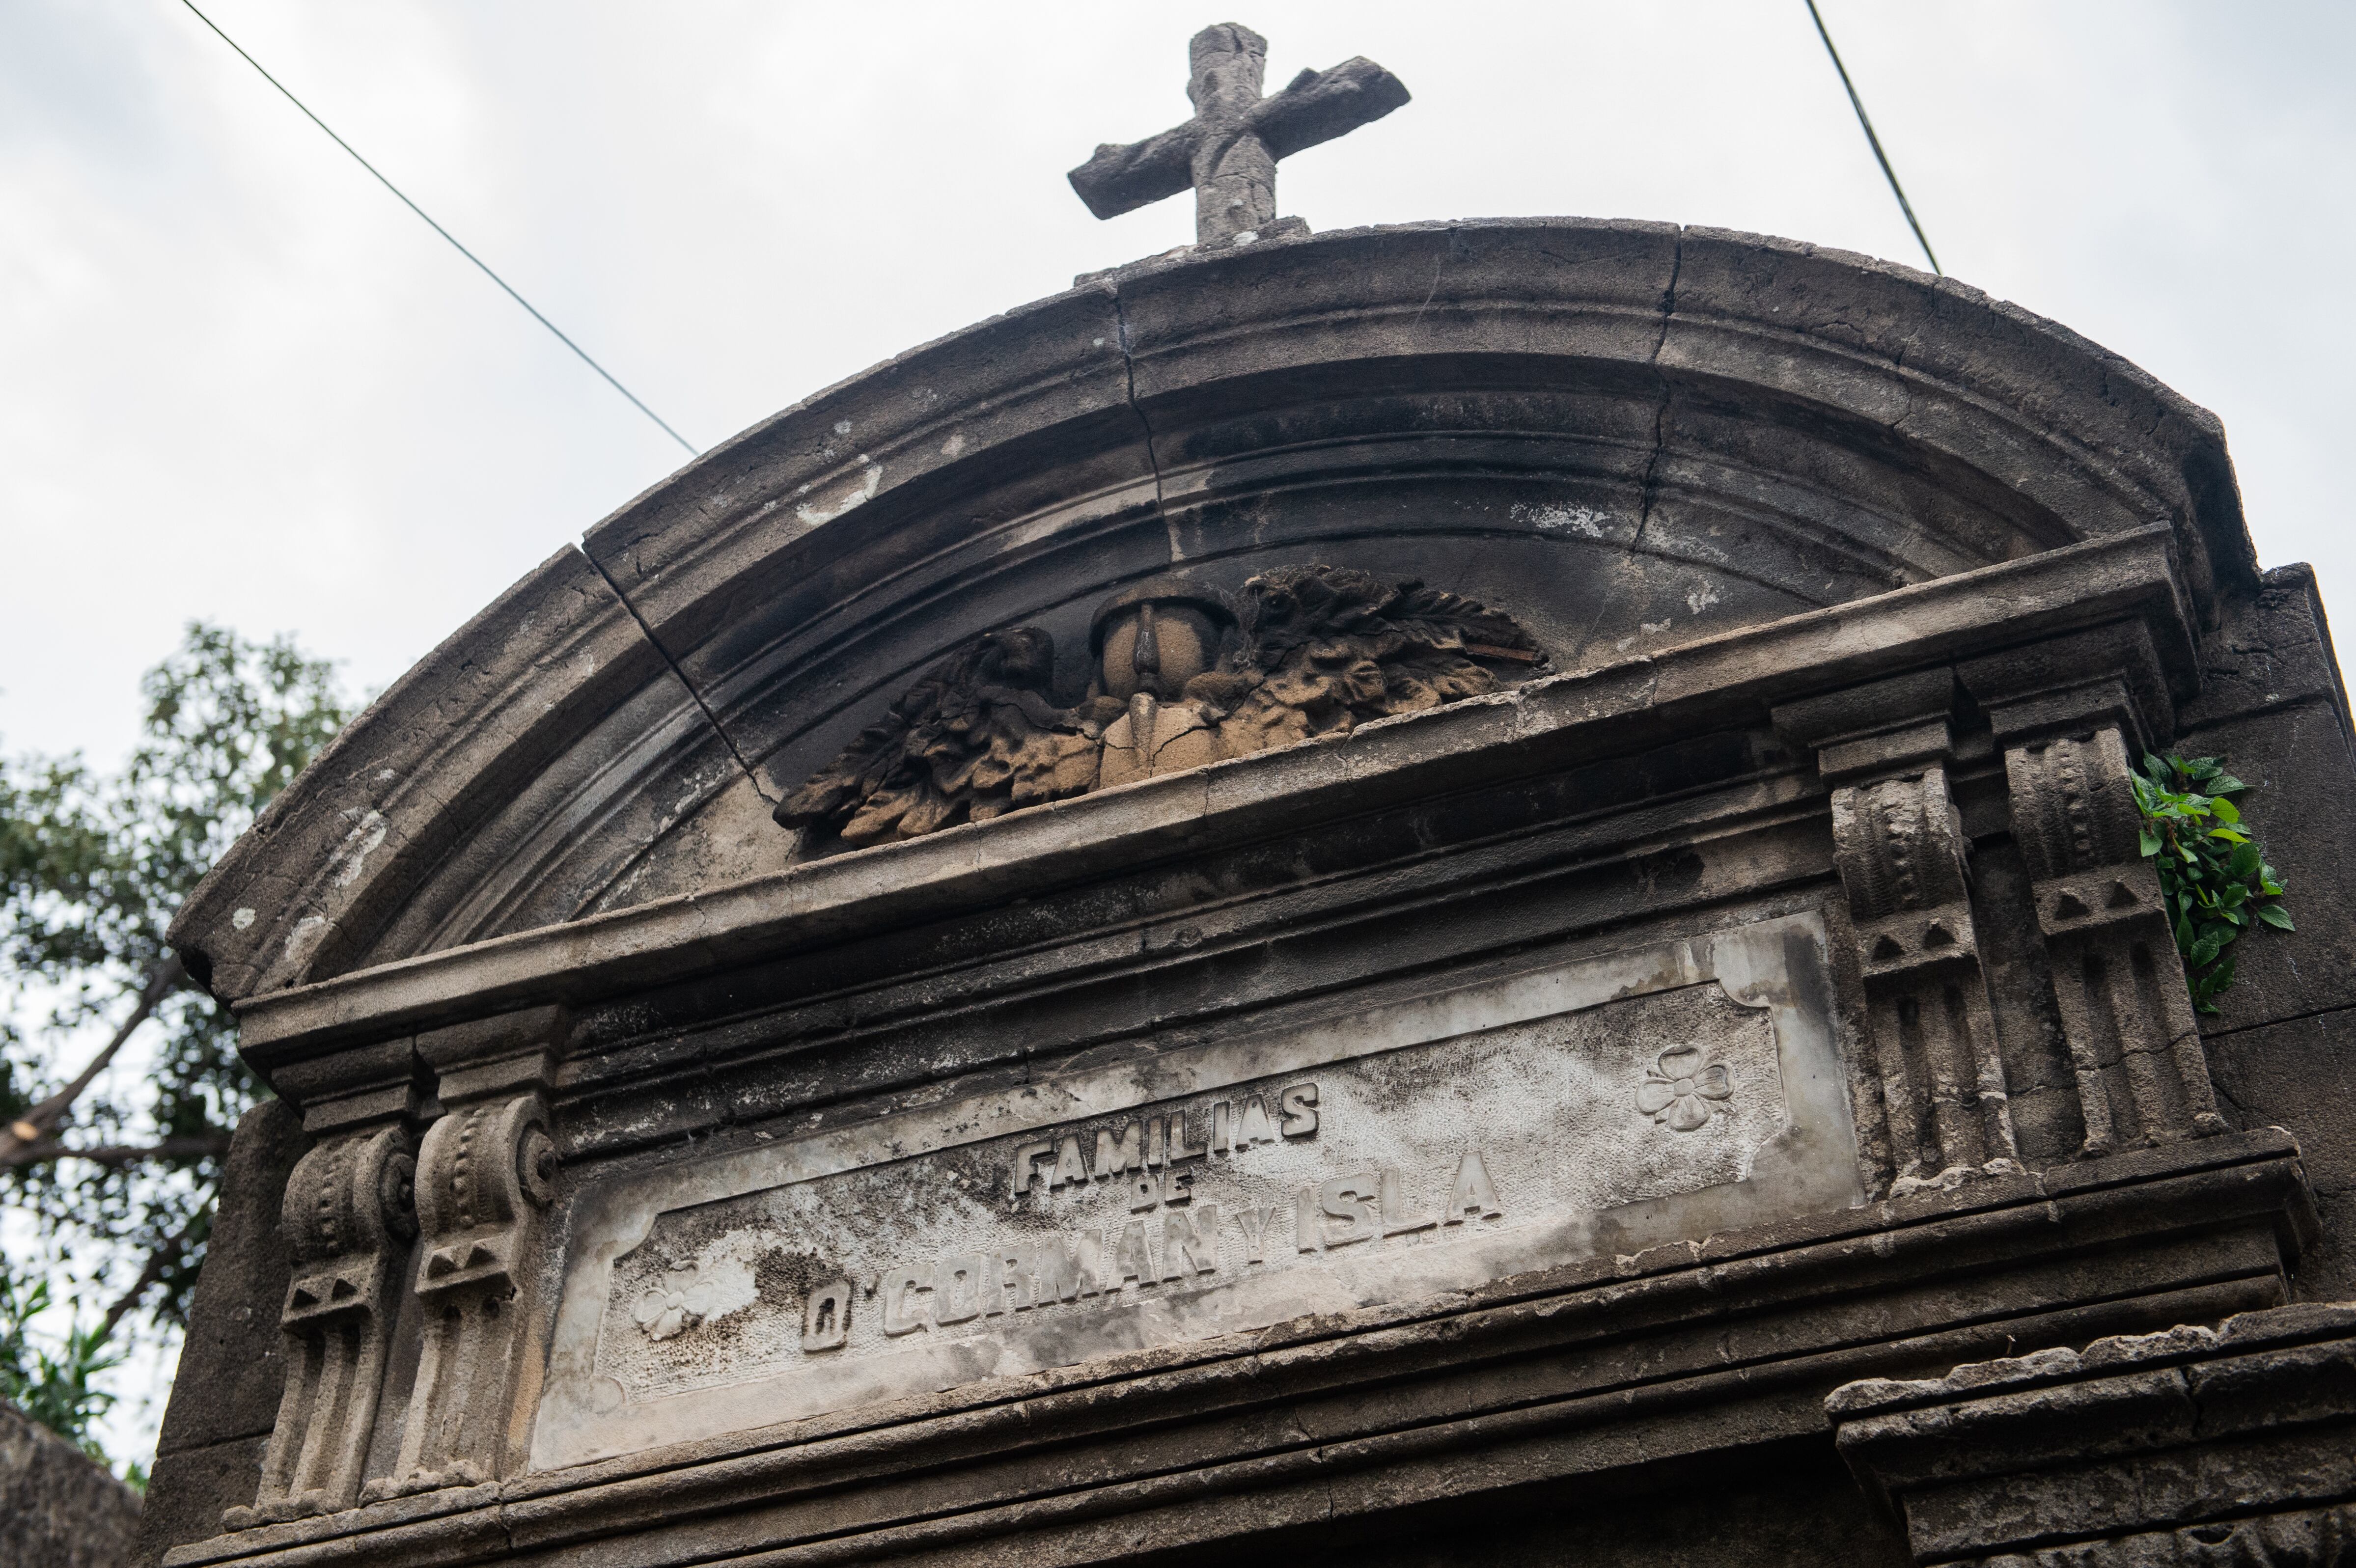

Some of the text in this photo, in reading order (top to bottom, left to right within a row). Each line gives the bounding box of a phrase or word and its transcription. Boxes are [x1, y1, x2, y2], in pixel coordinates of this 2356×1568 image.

[1014, 1082, 1320, 1196] FAMILIAS
[1130, 1166, 1193, 1214] DE
[1236, 1207, 1276, 1264] Y
[1297, 1151, 1502, 1254] ISLA
